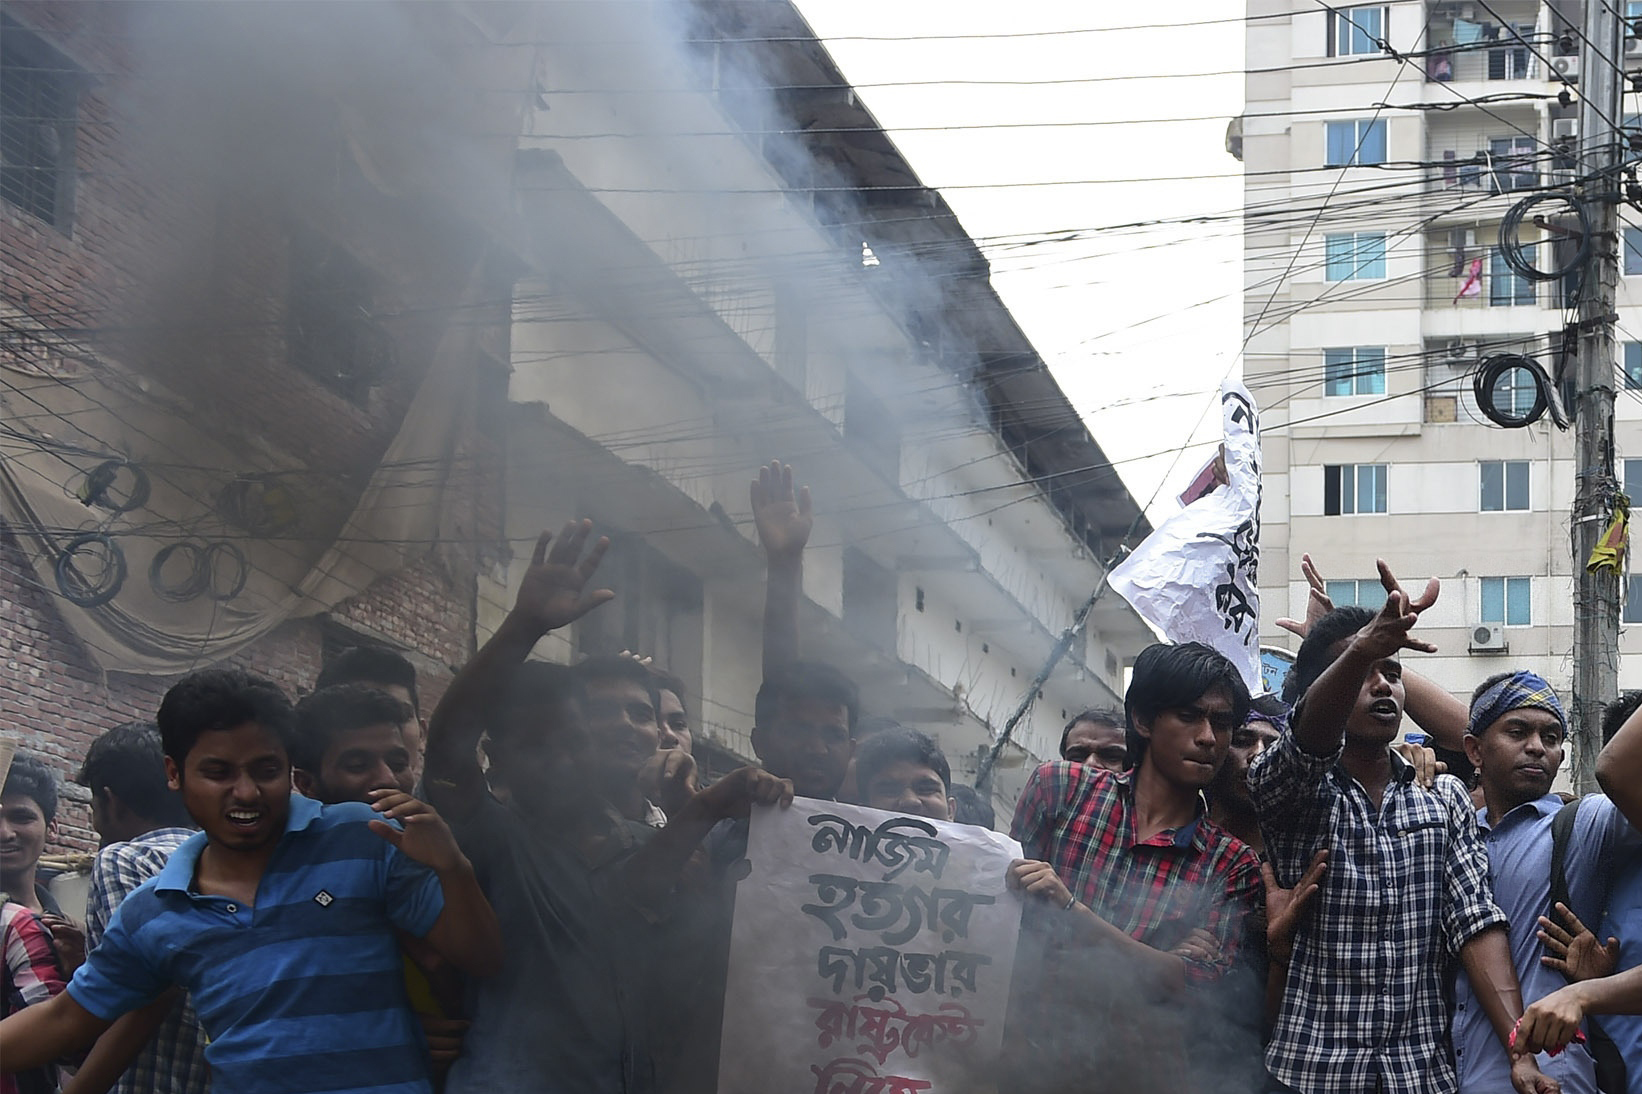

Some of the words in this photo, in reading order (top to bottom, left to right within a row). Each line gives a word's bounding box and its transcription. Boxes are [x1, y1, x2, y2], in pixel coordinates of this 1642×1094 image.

[807, 813, 951, 881] নাজিম
[801, 873, 996, 946] হত্যার
[818, 946, 993, 1002] দায়ভার
